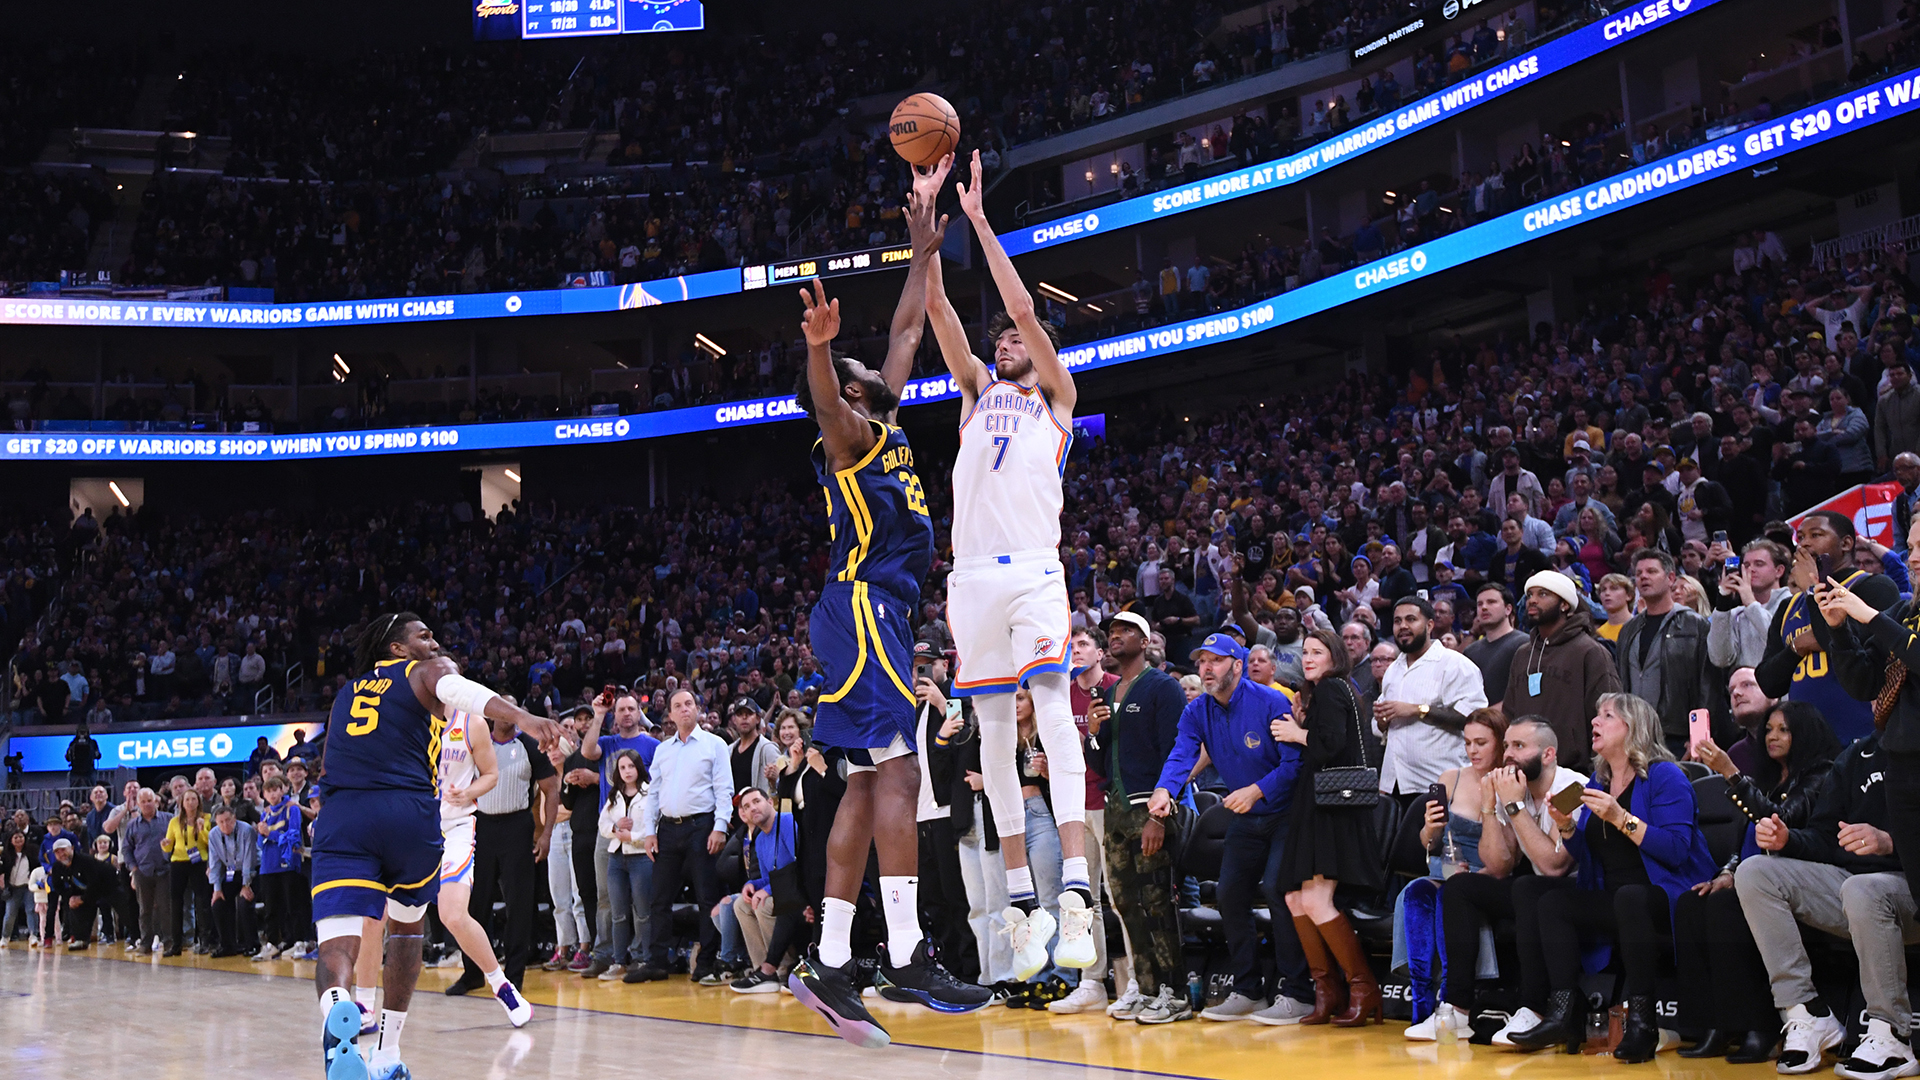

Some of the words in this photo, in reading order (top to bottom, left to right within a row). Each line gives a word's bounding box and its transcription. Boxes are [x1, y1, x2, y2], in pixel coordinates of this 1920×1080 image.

[475, 3, 519, 18] Sports
[1604, 1, 1671, 41] CHASE
[528, 22, 539, 31] FT
[551, 17, 577, 30] 17/21
[1355, 37, 1388, 58] FOUNDING
[1388, 19, 1424, 43] PARTNERS
[1153, 187, 1202, 212] SCORE
[1204, 174, 1250, 199] MORE
[1252, 168, 1274, 187] AT
[1277, 152, 1320, 180] EVERY
[1321, 119, 1395, 163] WARRIORS
[1397, 100, 1441, 130] GAME
[1441, 80, 1484, 111] WITH
[1486, 56, 1539, 92] CHASE
[1524, 197, 1582, 232] CHASE
[1585, 145, 1737, 210] CARDHOLDERS:
[1744, 125, 1786, 156] GET
[1790, 110, 1832, 141] $20
[1835, 91, 1881, 124] OFF
[1034, 219, 1084, 244] CHASE
[775, 266, 798, 279] MEM
[799, 262, 816, 276] 120
[828, 259, 851, 271] SAS
[1355, 258, 1409, 289] CHASE
[5, 304, 64, 319] SCORE
[68, 304, 122, 320] MORE
[124, 306, 149, 321] AT
[153, 307, 207, 322] EVERY
[210, 308, 302, 324] WARRIORS
[305, 306, 353, 322] GAME
[355, 303, 399, 319] WITH
[402, 300, 455, 317] CHASE
[1097, 337, 1147, 361] WHEN
[1149, 328, 1184, 350] YOU
[1186, 317, 1240, 342] SPEND
[1241, 305, 1274, 330] $100
[901, 384, 919, 400] ET
[920, 380, 947, 398] $20
[715, 402, 765, 423] CHASE
[985, 413, 1021, 433] CITY
[6, 439, 42, 454] GET
[45, 438, 77, 454] $20
[81, 439, 116, 454] OFF
[120, 440, 217, 455] WARRIORS
[219, 440, 268, 455] SHOP
[271, 438, 320, 454] WHEN
[325, 436, 361, 452] YOU
[364, 433, 418, 450] SPEND
[420, 430, 459, 447] $100
[555, 422, 613, 439] CHASE
[990, 435, 1012, 472] 7
[899, 472, 929, 516] 22
[346, 695, 380, 736] 5
[118, 737, 206, 760] CHASE
